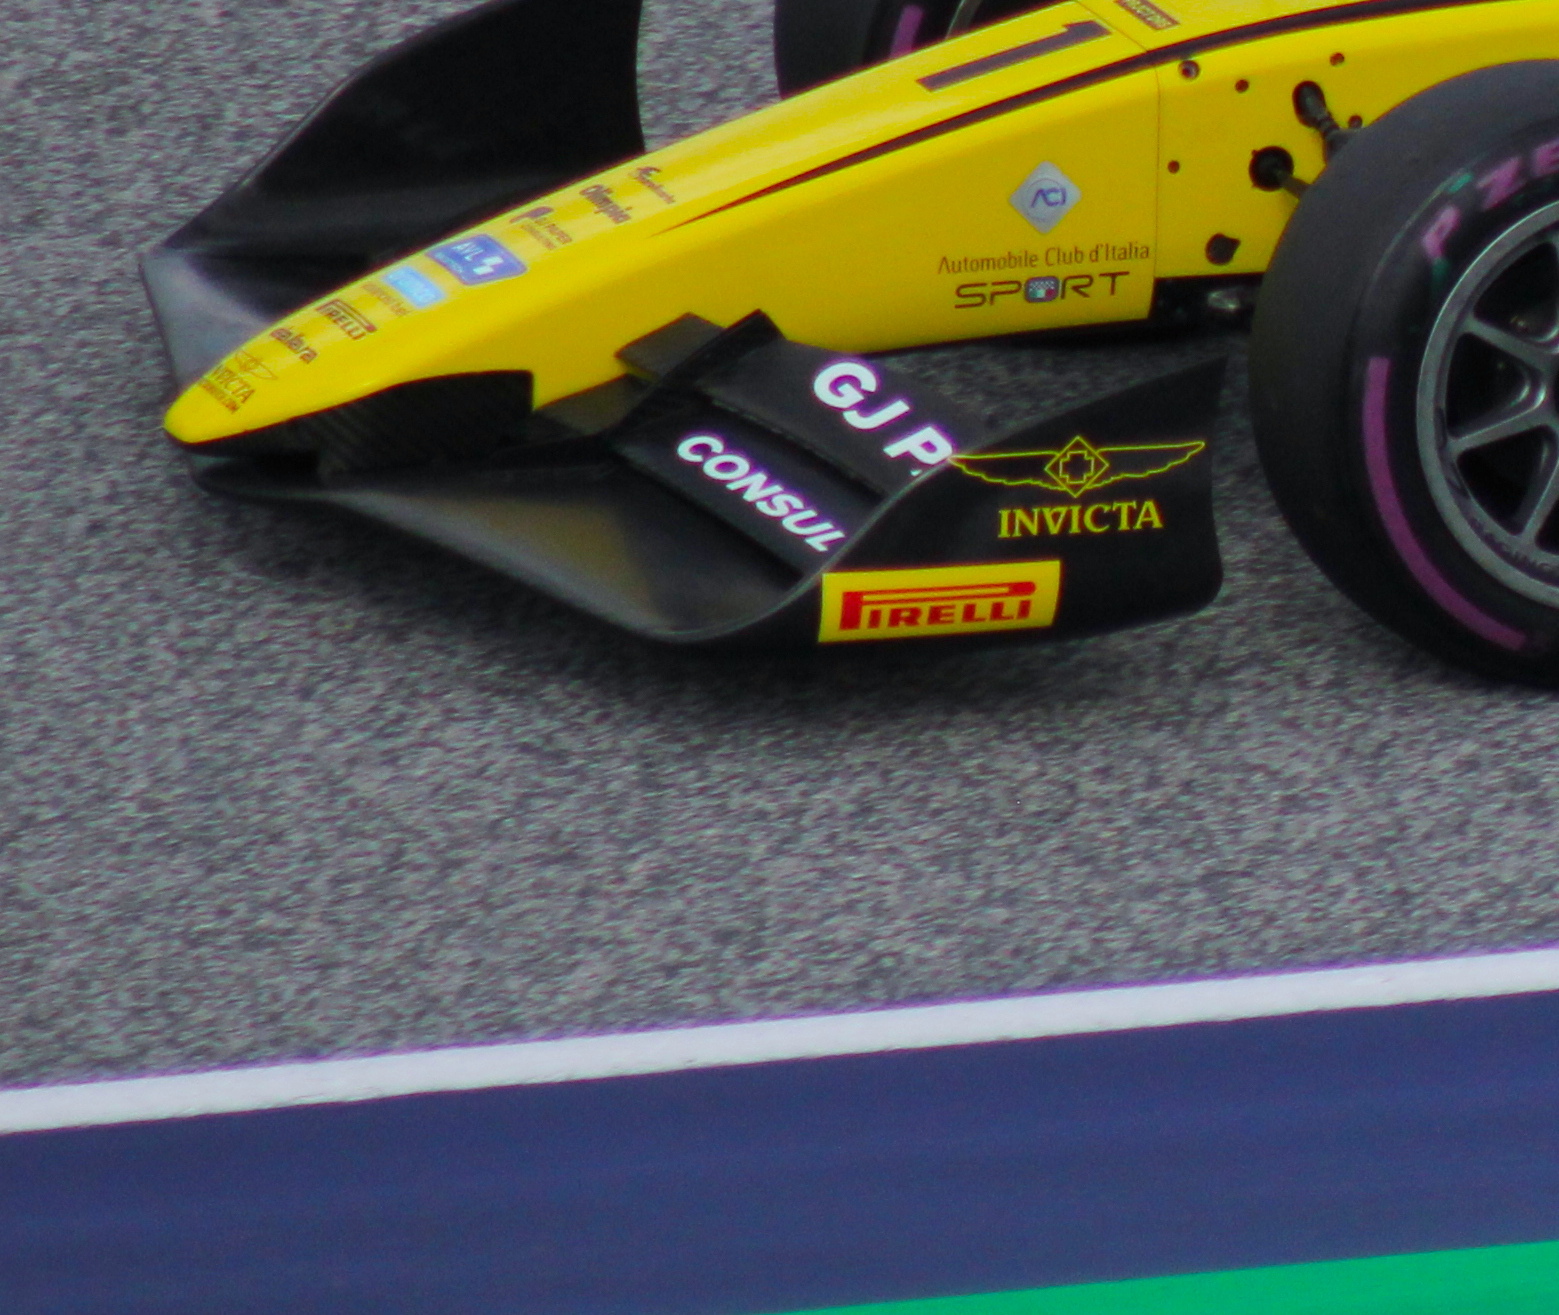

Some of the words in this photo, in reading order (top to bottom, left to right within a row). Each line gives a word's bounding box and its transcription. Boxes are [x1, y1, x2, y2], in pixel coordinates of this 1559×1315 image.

[937, 250, 1039, 275] Automobile
[1044, 246, 1084, 267] Club
[1088, 241, 1150, 263] d'Italia
[1420, 204, 1462, 262] P
[813, 360, 910, 431] GJ
[884, 424, 957, 477] P
[998, 499, 1164, 541] INVICTA
[838, 580, 1038, 632] PIRELLI
